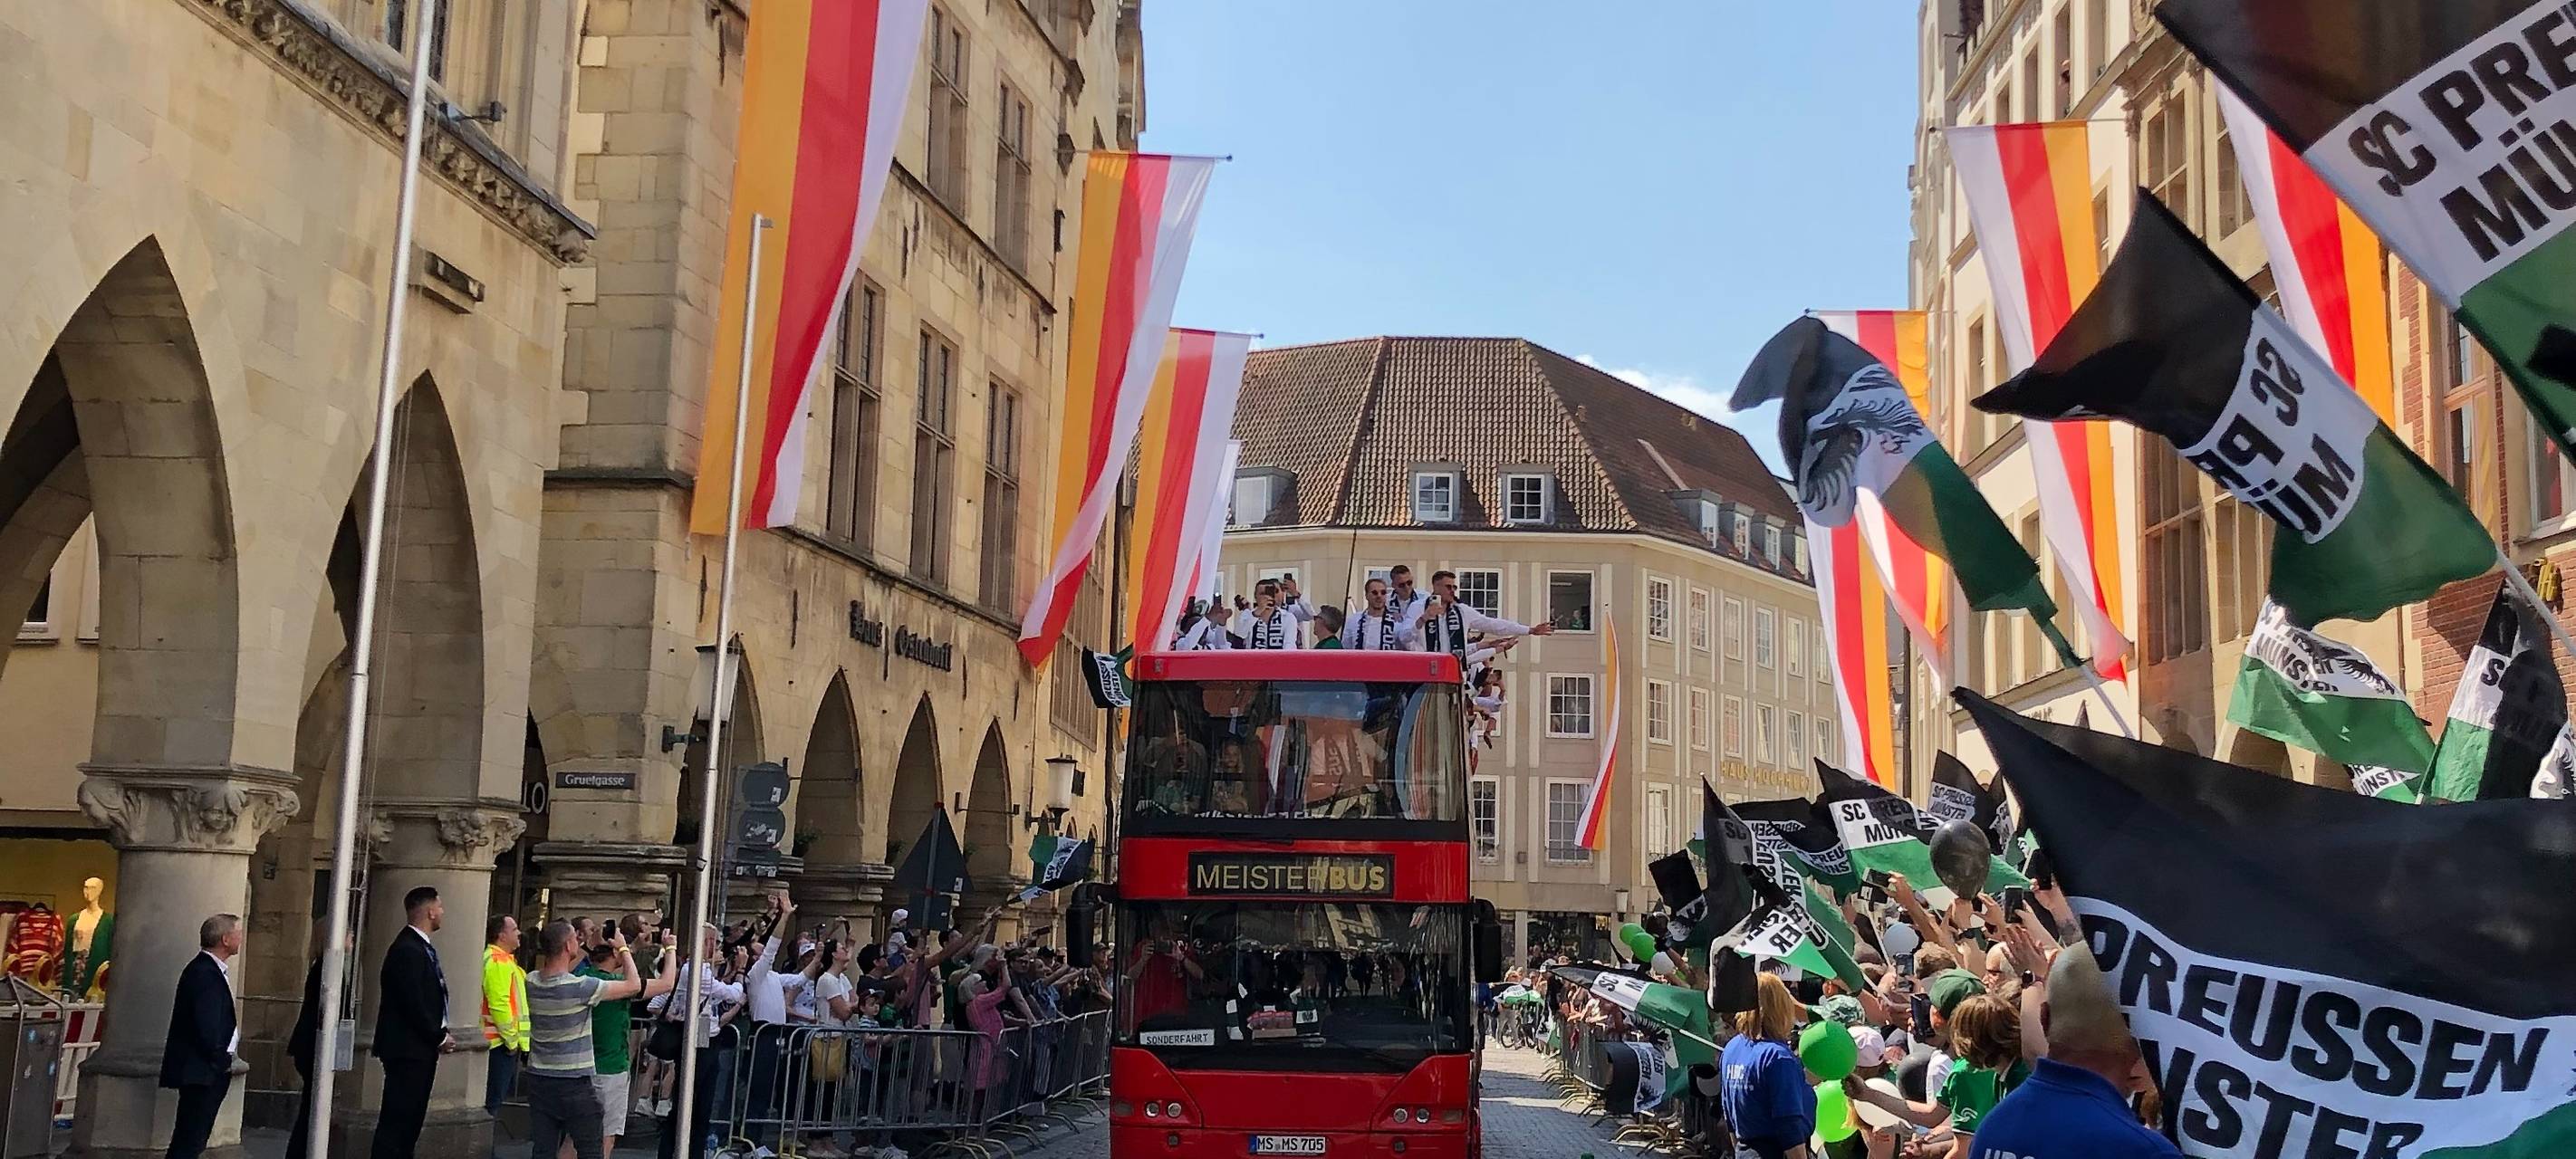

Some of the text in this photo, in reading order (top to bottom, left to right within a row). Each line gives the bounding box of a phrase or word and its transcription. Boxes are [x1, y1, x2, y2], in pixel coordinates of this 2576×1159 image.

[2347, 0, 2576, 197] SC PRE
[565, 773, 625, 787] Gruelgasse
[1841, 802, 1866, 822] SC
[1197, 864, 1386, 892] MEISTERBUS
[1146, 1033, 1208, 1045] SONDERFAHRT
[1257, 1137, 1324, 1151] MS MS 705
